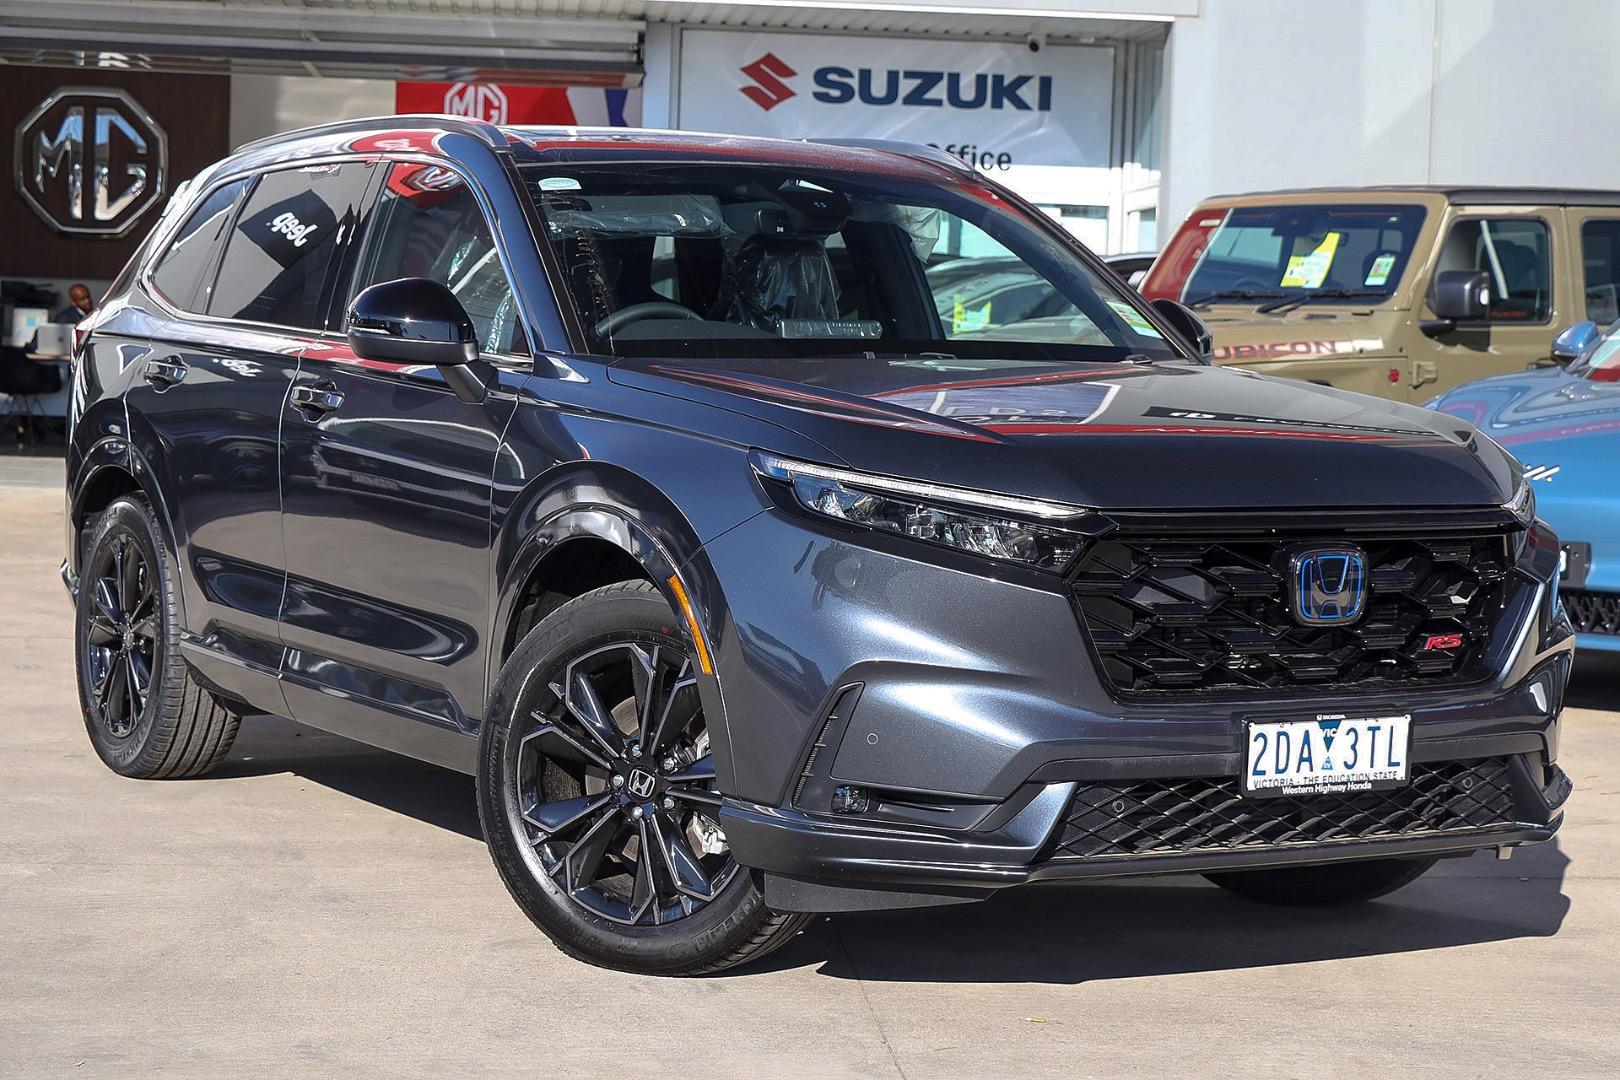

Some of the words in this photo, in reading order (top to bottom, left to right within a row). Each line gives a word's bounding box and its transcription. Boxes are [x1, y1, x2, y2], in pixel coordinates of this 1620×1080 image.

[812, 66, 1053, 112] SUZUKI
[451, 83, 500, 125] MG
[34, 106, 149, 221] MG
[926, 143, 1012, 171] fice
[1212, 339, 1338, 360] UBICON
[1424, 633, 1463, 649] RS
[1252, 729, 1314, 776] 2DA
[1343, 725, 1401, 770] 3TL
[1253, 778, 1294, 789] VICTORIA
[1303, 776, 1319, 785] THE
[1322, 773, 1370, 783] EDUCATION
[1373, 770, 1398, 780] STATE
[1282, 785, 1314, 795] Western
[1315, 783, 1347, 794] Highway
[1347, 781, 1372, 790] Honda
